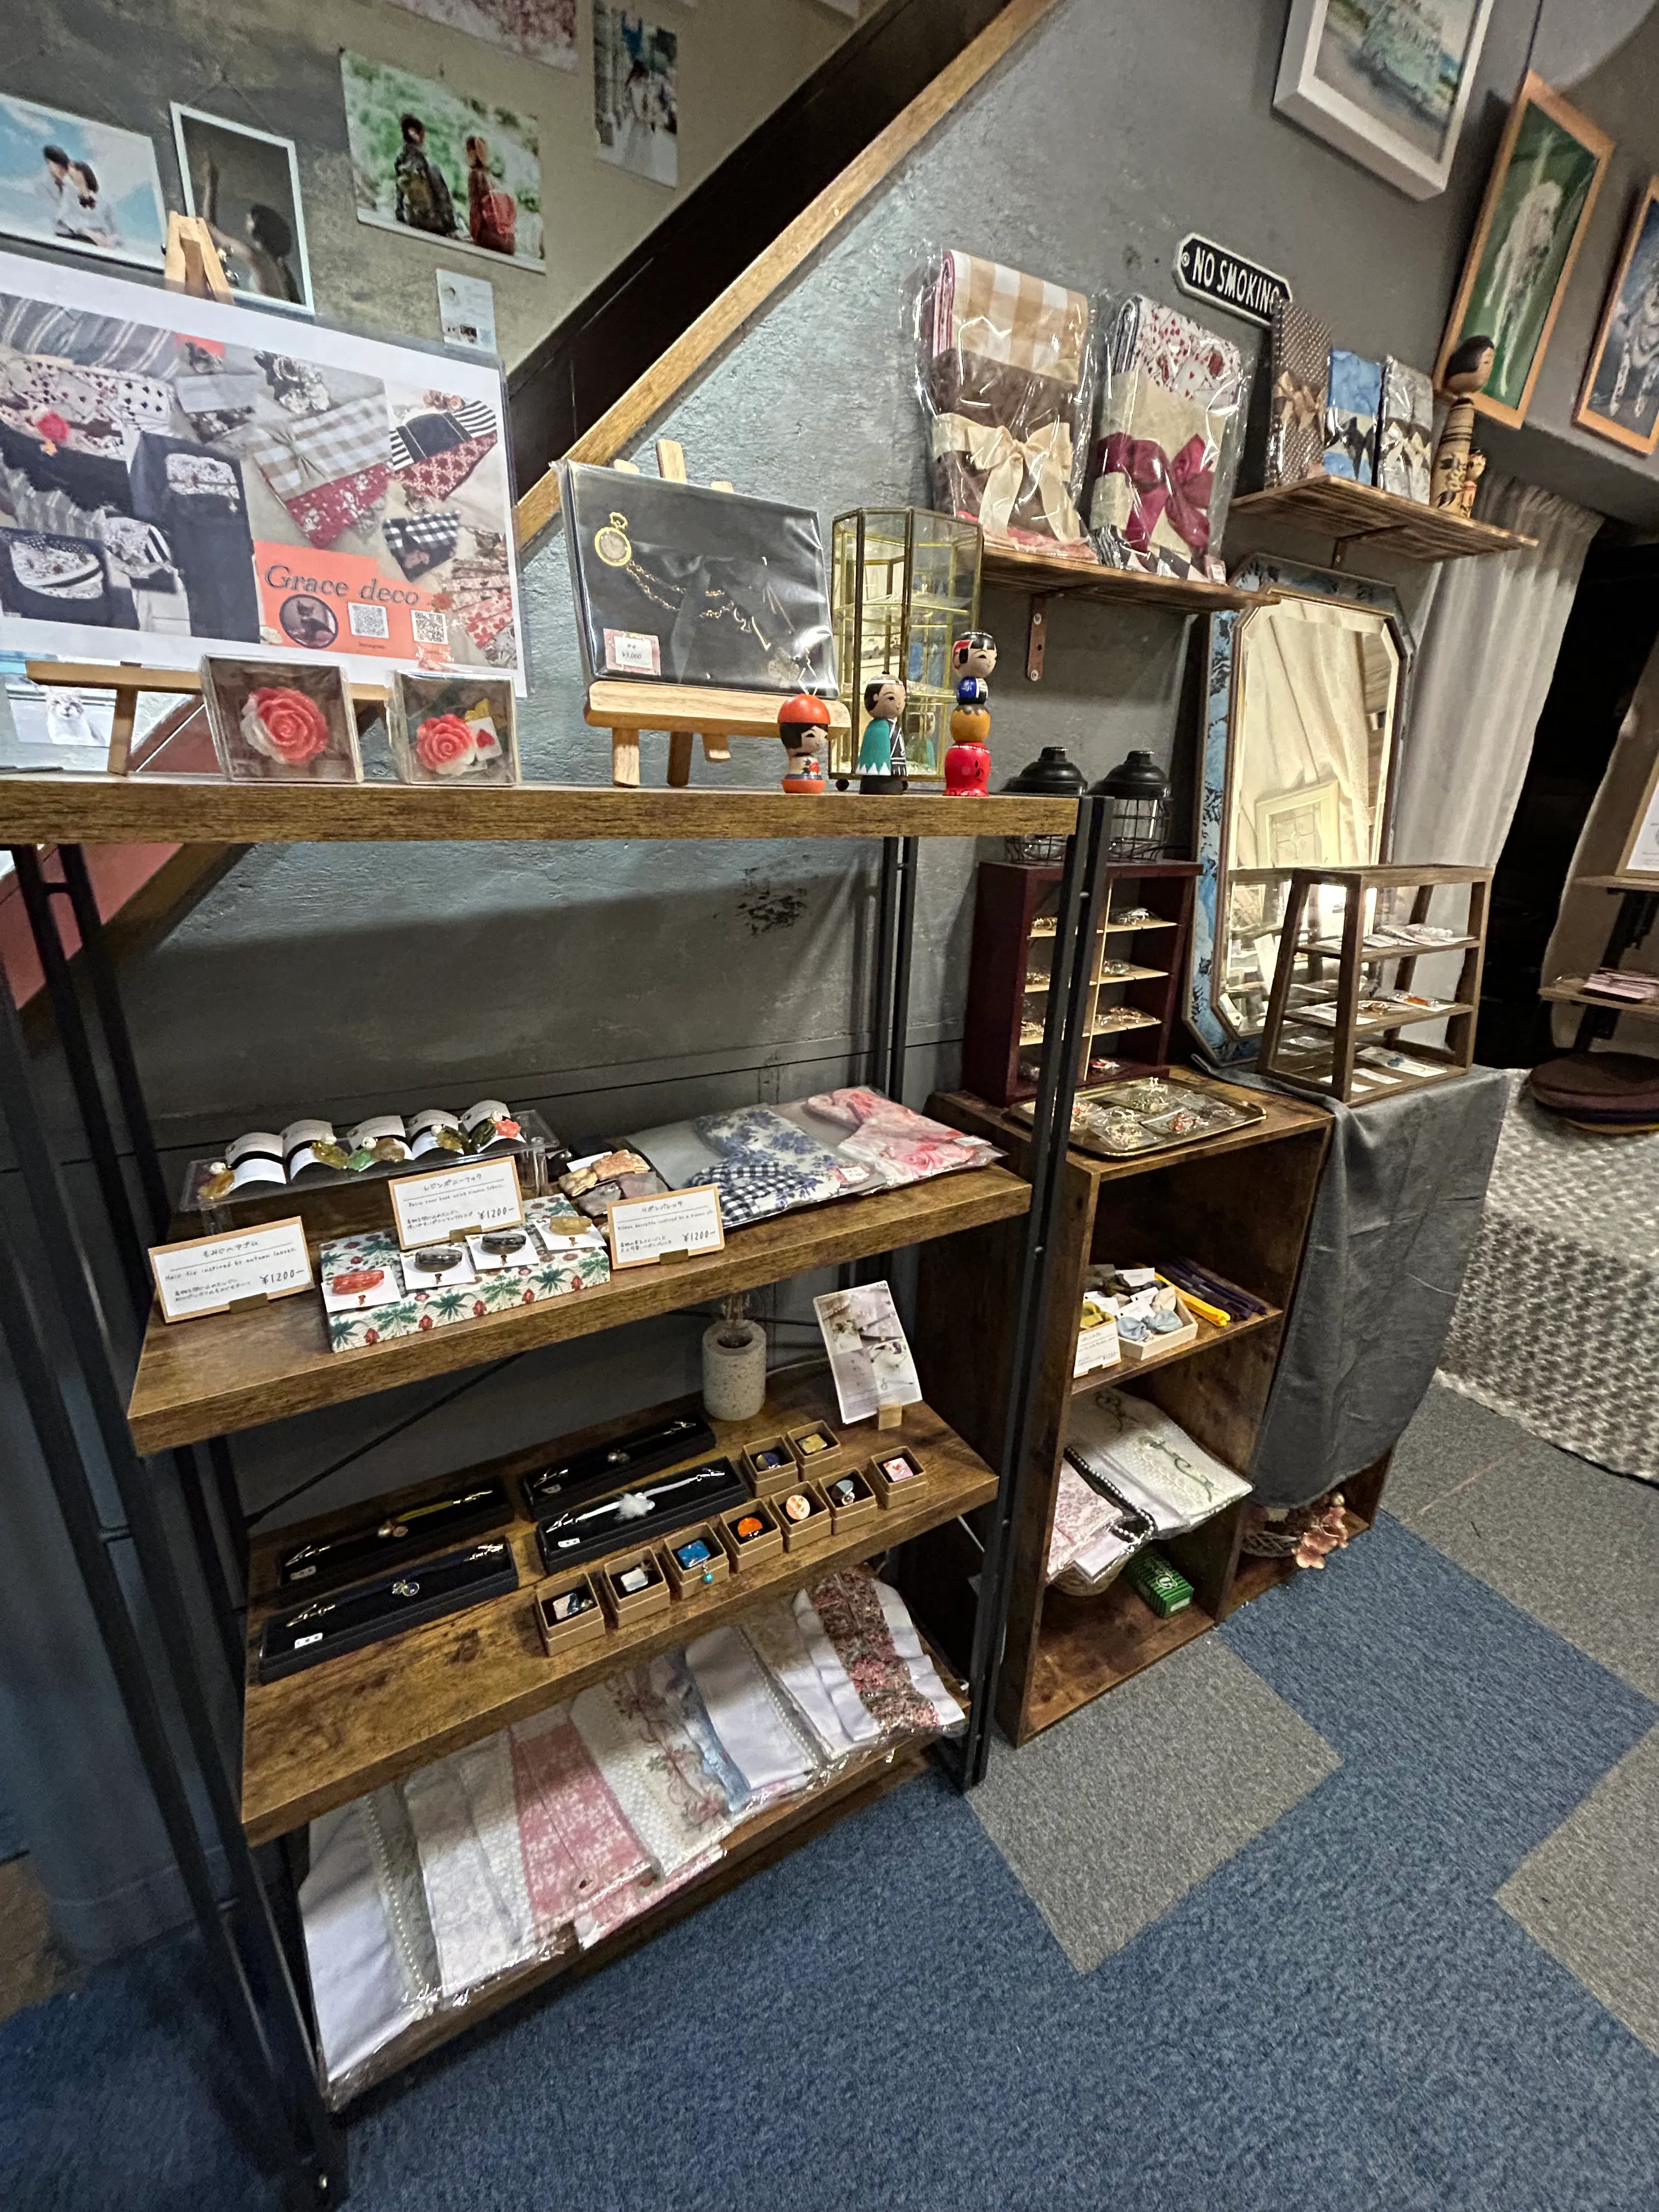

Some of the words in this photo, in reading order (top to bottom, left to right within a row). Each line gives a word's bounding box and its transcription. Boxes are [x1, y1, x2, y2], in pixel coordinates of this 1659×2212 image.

[1192, 247, 1215, 287] NO
[265, 565, 349, 597] Grace
[360, 578, 419, 605] deco
